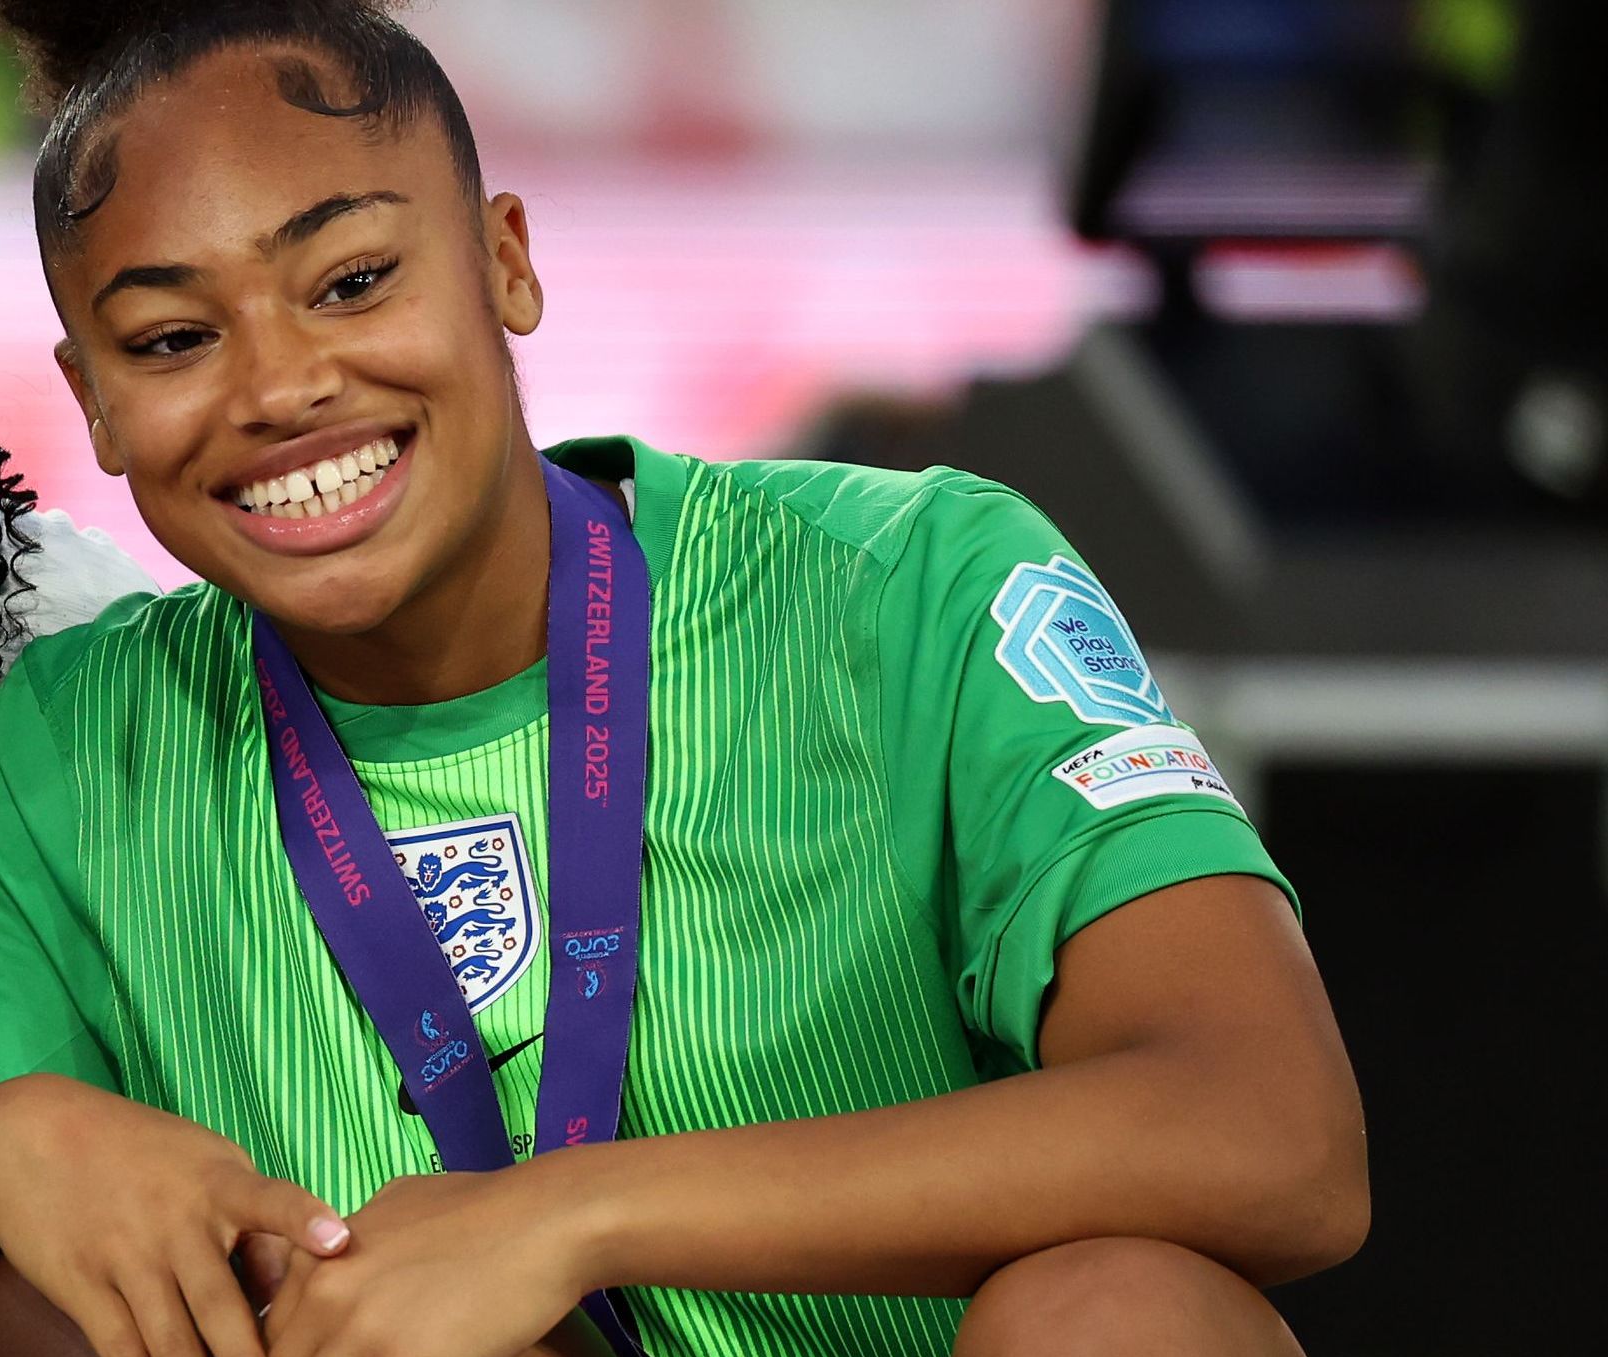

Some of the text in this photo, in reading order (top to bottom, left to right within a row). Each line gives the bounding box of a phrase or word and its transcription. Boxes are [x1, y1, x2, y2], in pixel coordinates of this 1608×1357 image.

[1053, 617, 1089, 634] We
[583, 519, 613, 801] SWITZERLAND 2025
[1084, 654, 1144, 676] Strong
[1062, 750, 1104, 774] UEFA
[280, 726, 371, 907] SWITZERLAND
